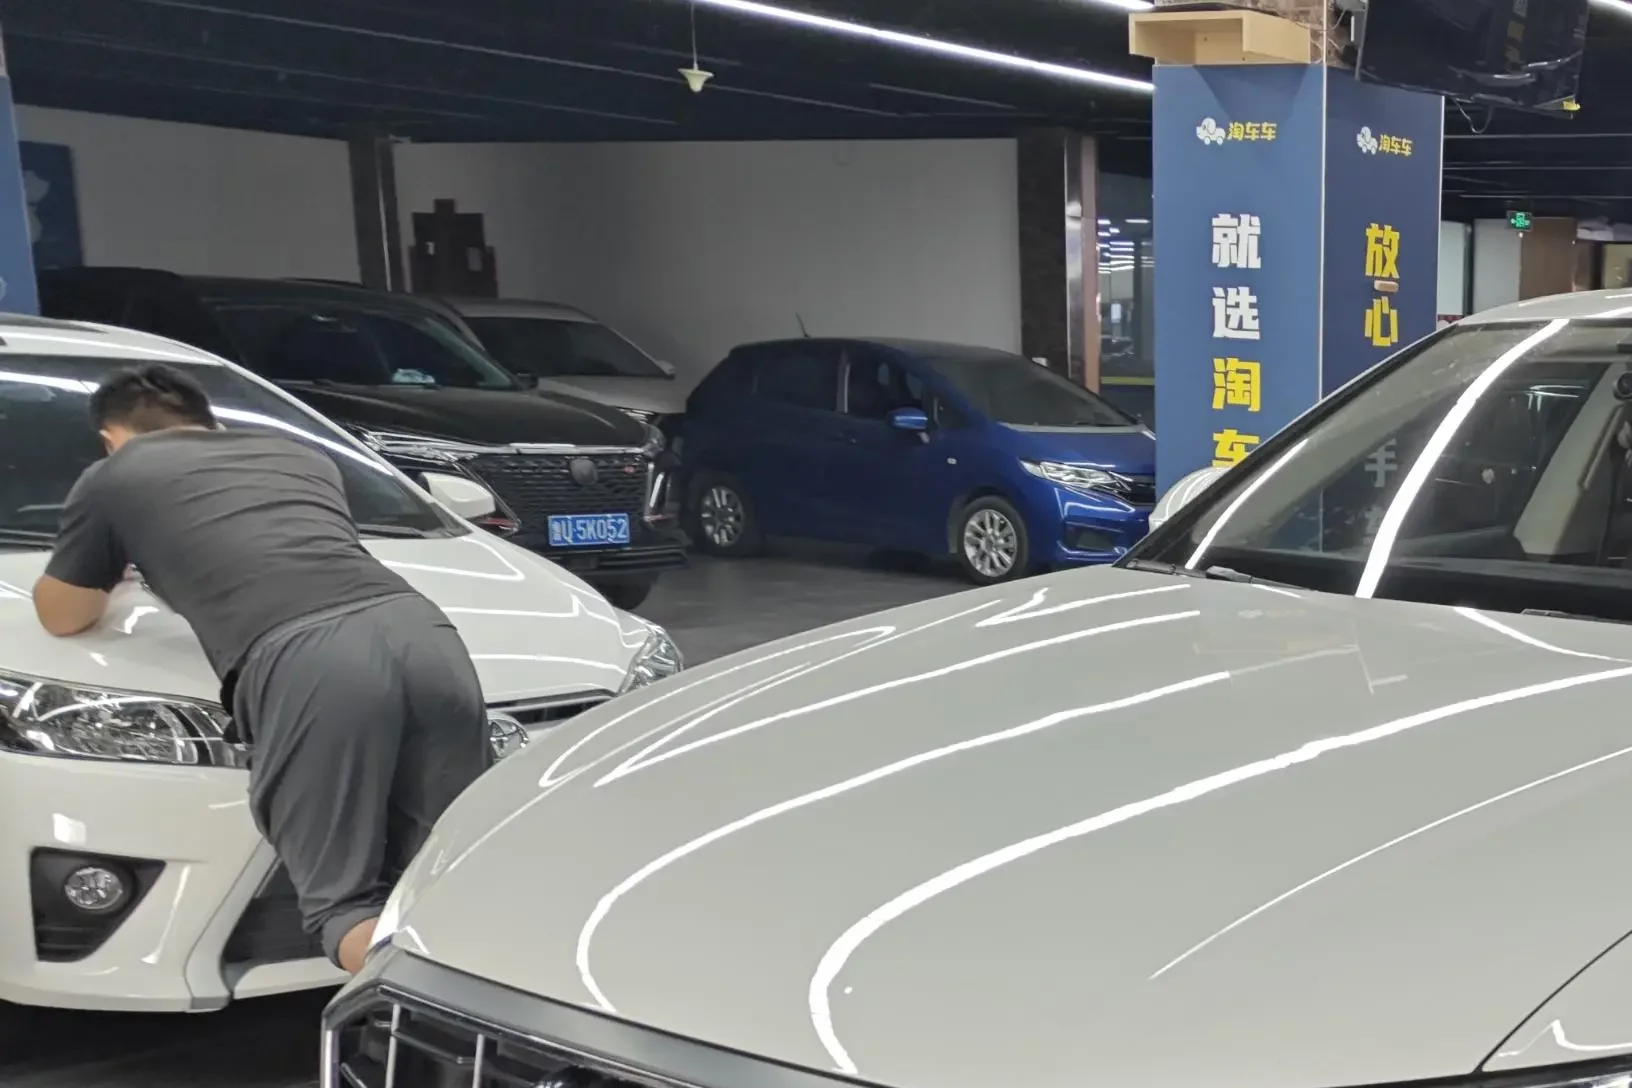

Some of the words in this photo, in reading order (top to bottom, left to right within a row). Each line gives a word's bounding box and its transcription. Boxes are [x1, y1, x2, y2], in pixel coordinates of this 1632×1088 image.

[1227, 121, 1277, 141] 淘车车
[1379, 134, 1413, 156] 淘车车
